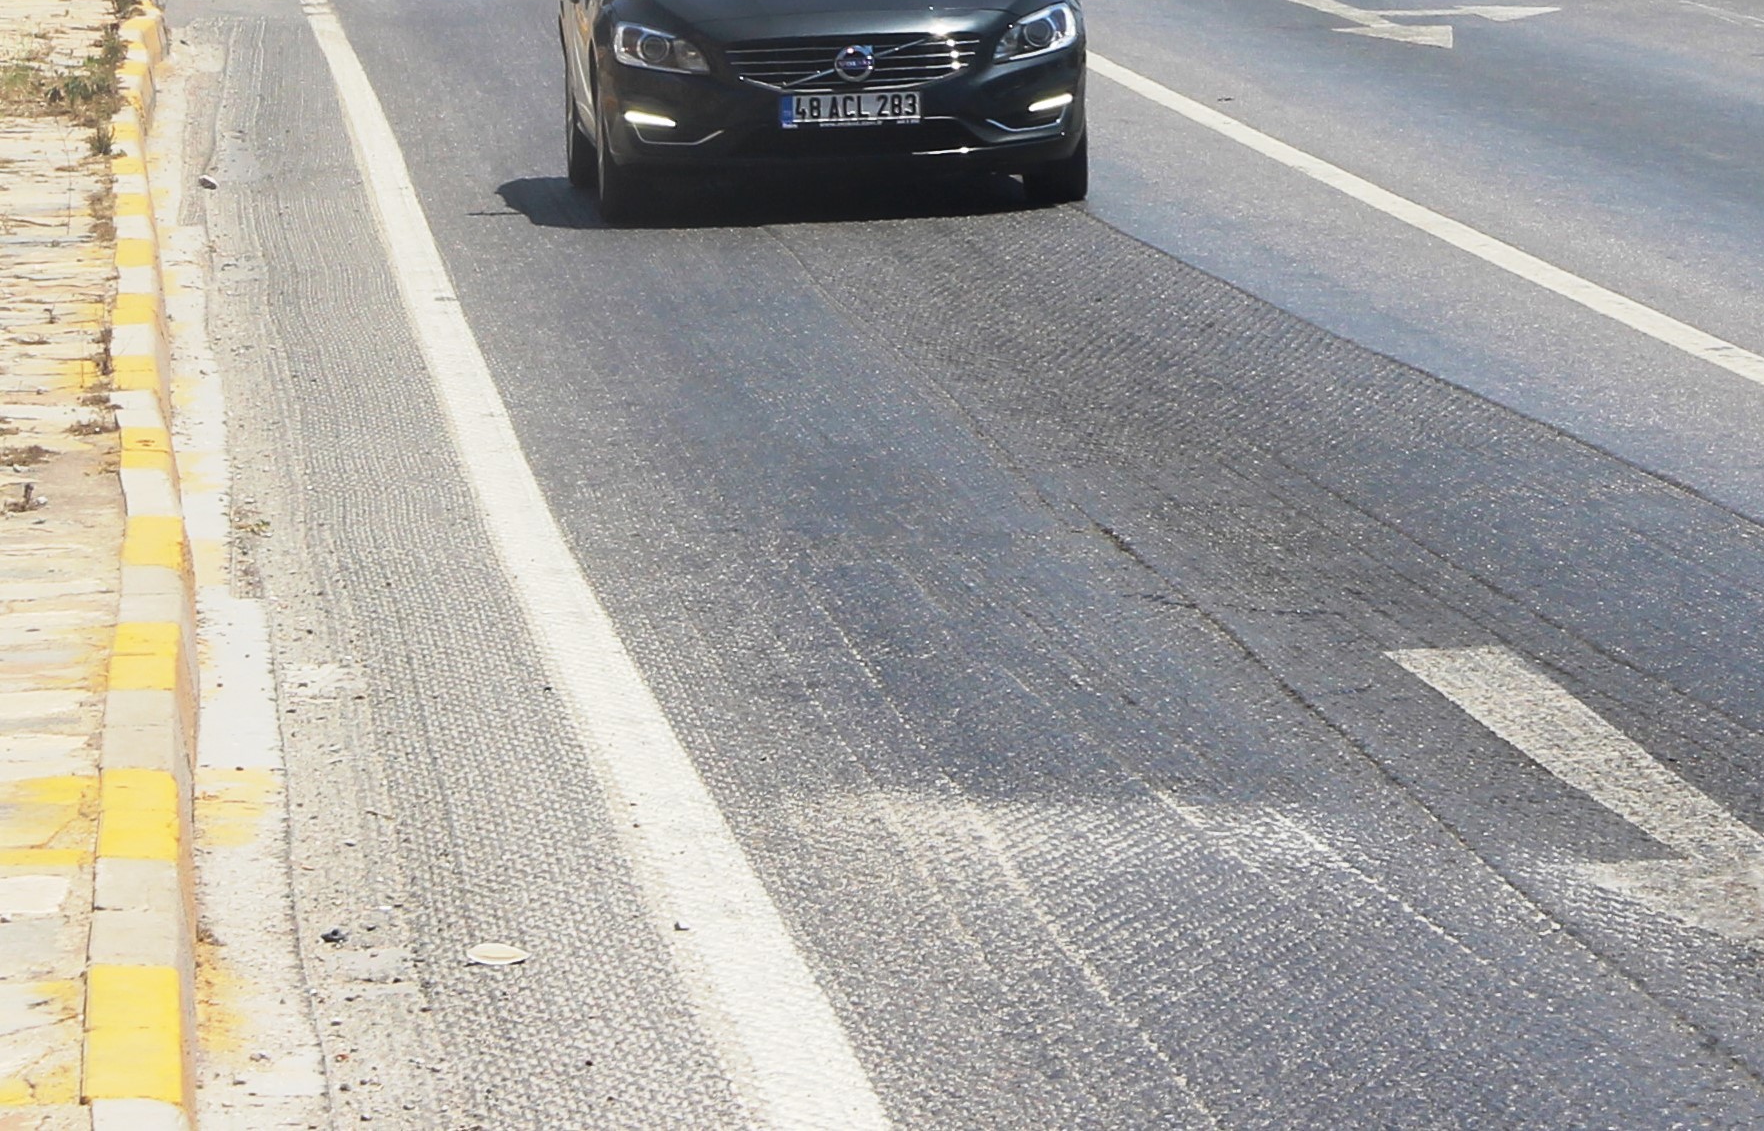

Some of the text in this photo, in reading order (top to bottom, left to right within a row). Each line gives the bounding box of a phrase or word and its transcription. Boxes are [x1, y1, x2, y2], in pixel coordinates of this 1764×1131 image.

[795, 93, 917, 119] 48 ACL 283
